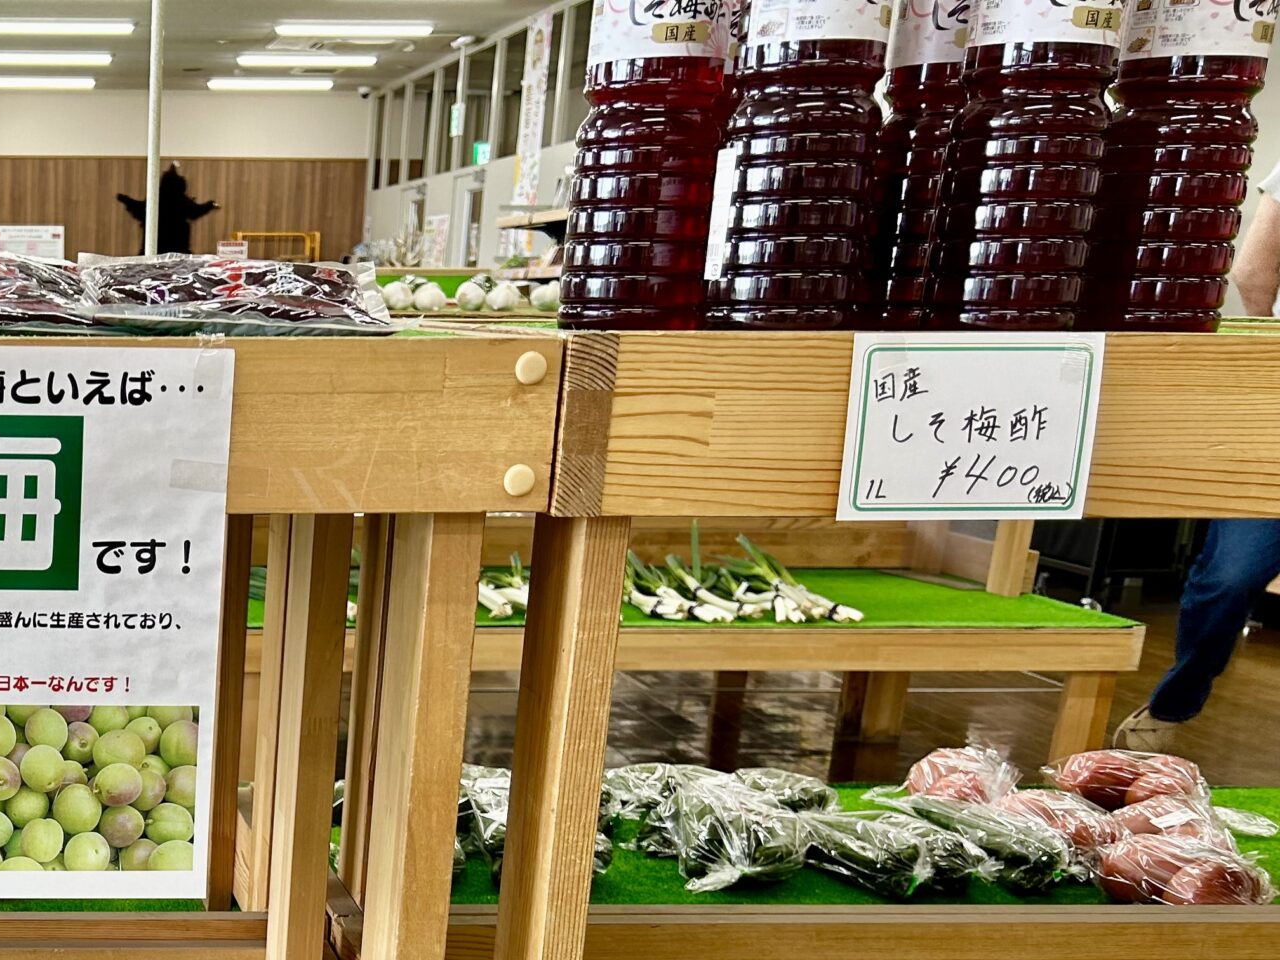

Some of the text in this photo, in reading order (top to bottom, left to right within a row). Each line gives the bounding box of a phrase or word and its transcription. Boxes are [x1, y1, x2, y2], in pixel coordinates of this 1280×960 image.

[664, 25, 697, 42] 国産
[1086, 10, 1113, 29] 国産
[874, 368, 928, 401] 国産
[893, 405, 1048, 443] しそ梅酢
[866, 479, 887, 499] 1L
[932, 454, 1040, 499] ¥400
[92, 538, 191, 574] です！
